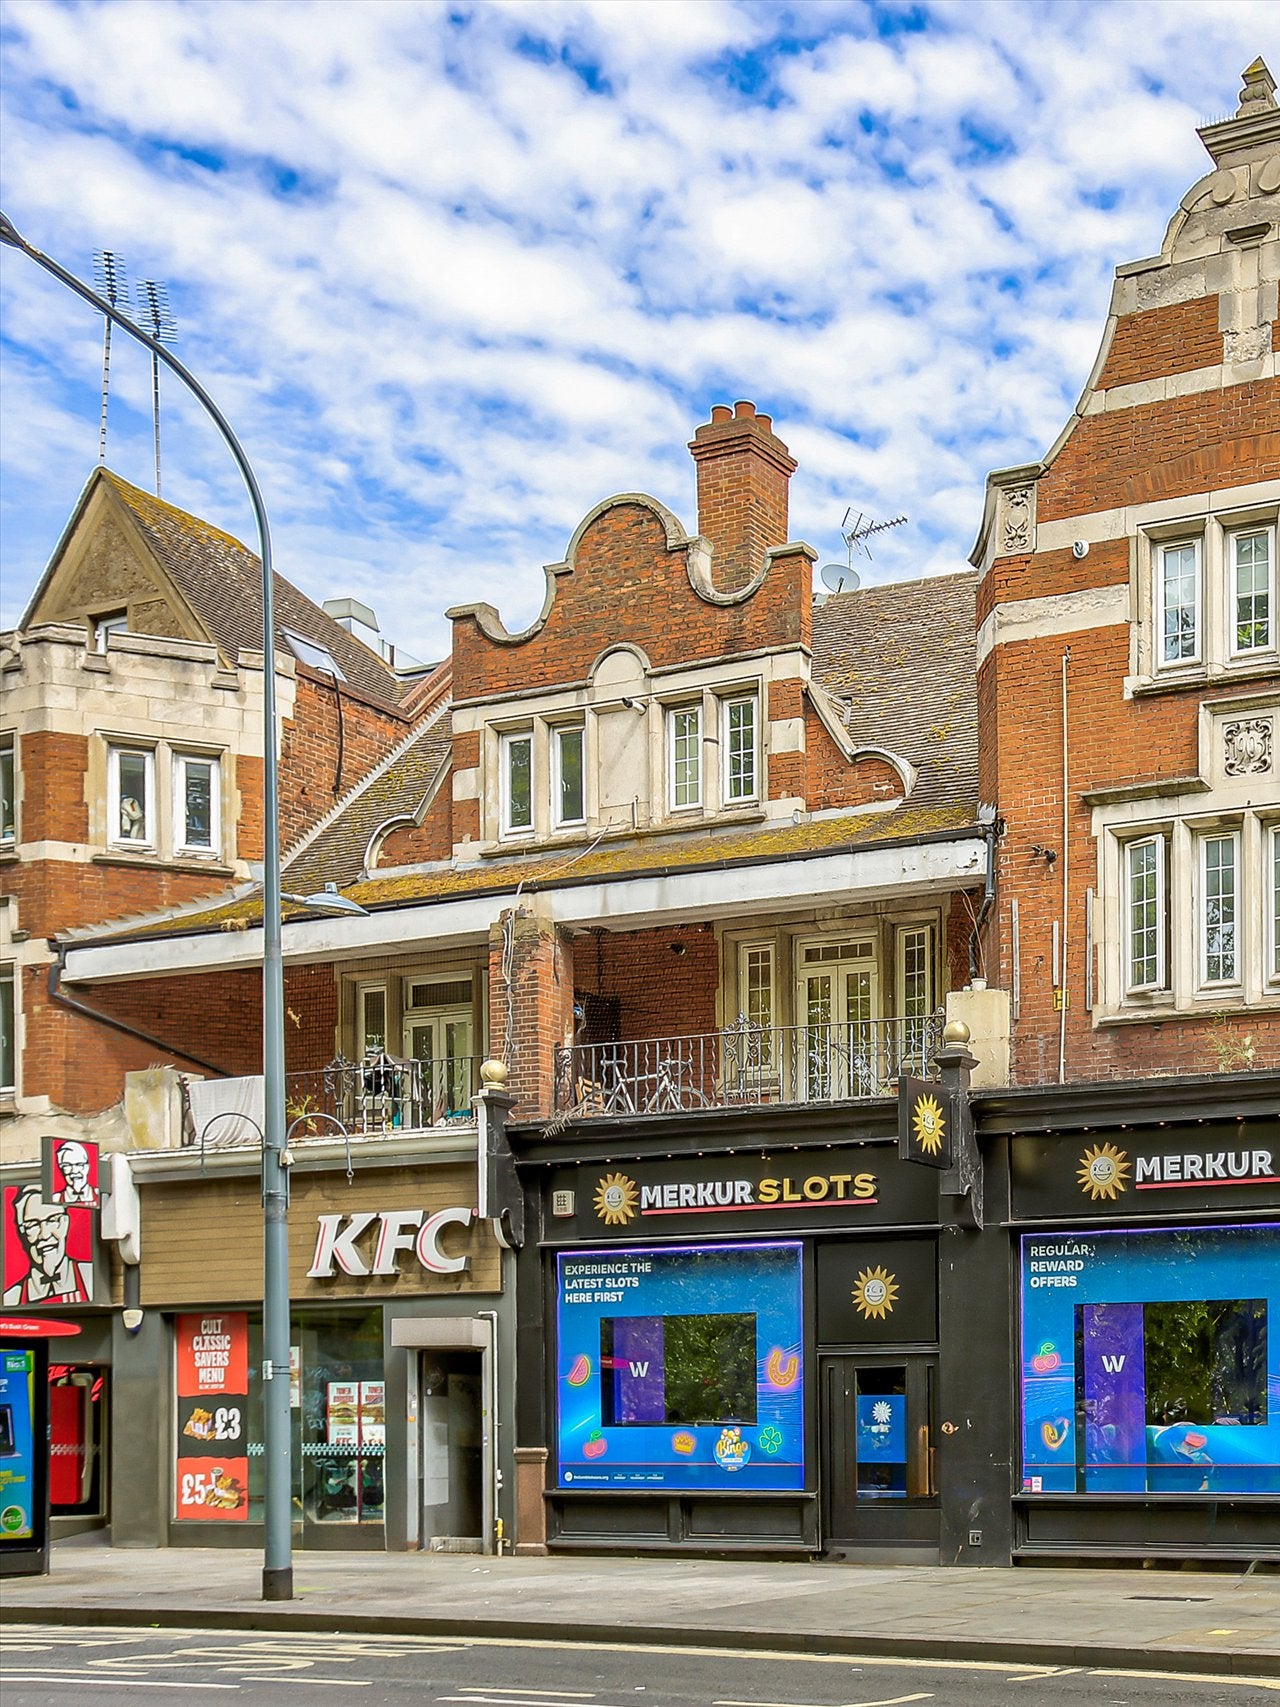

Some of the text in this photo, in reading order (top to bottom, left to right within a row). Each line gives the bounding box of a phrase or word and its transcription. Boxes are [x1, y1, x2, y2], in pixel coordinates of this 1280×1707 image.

[1135, 1150, 1275, 1182] MERKUR
[641, 1173, 877, 1209] MERKUR SLOTS
[306, 1207, 473, 1278] KFC
[1030, 1244, 1089, 1257] REGULAR
[564, 1262, 652, 1276] EXPERIENCE THE
[1030, 1260, 1084, 1273] REWARD
[564, 1277, 639, 1290] LATEST SLOTS
[1030, 1276, 1078, 1288] OFFERS
[564, 1292, 625, 1304] HERE FIRST
[201, 1319, 222, 1334] CULT
[192, 1335, 231, 1351] CLASSIC
[194, 1351, 229, 1367] SAVERS
[198, 1367, 225, 1383] MENU
[214, 1407, 242, 1440] £3
[716, 1439, 749, 1458] Bingo
[181, 1473, 207, 1505] £5
